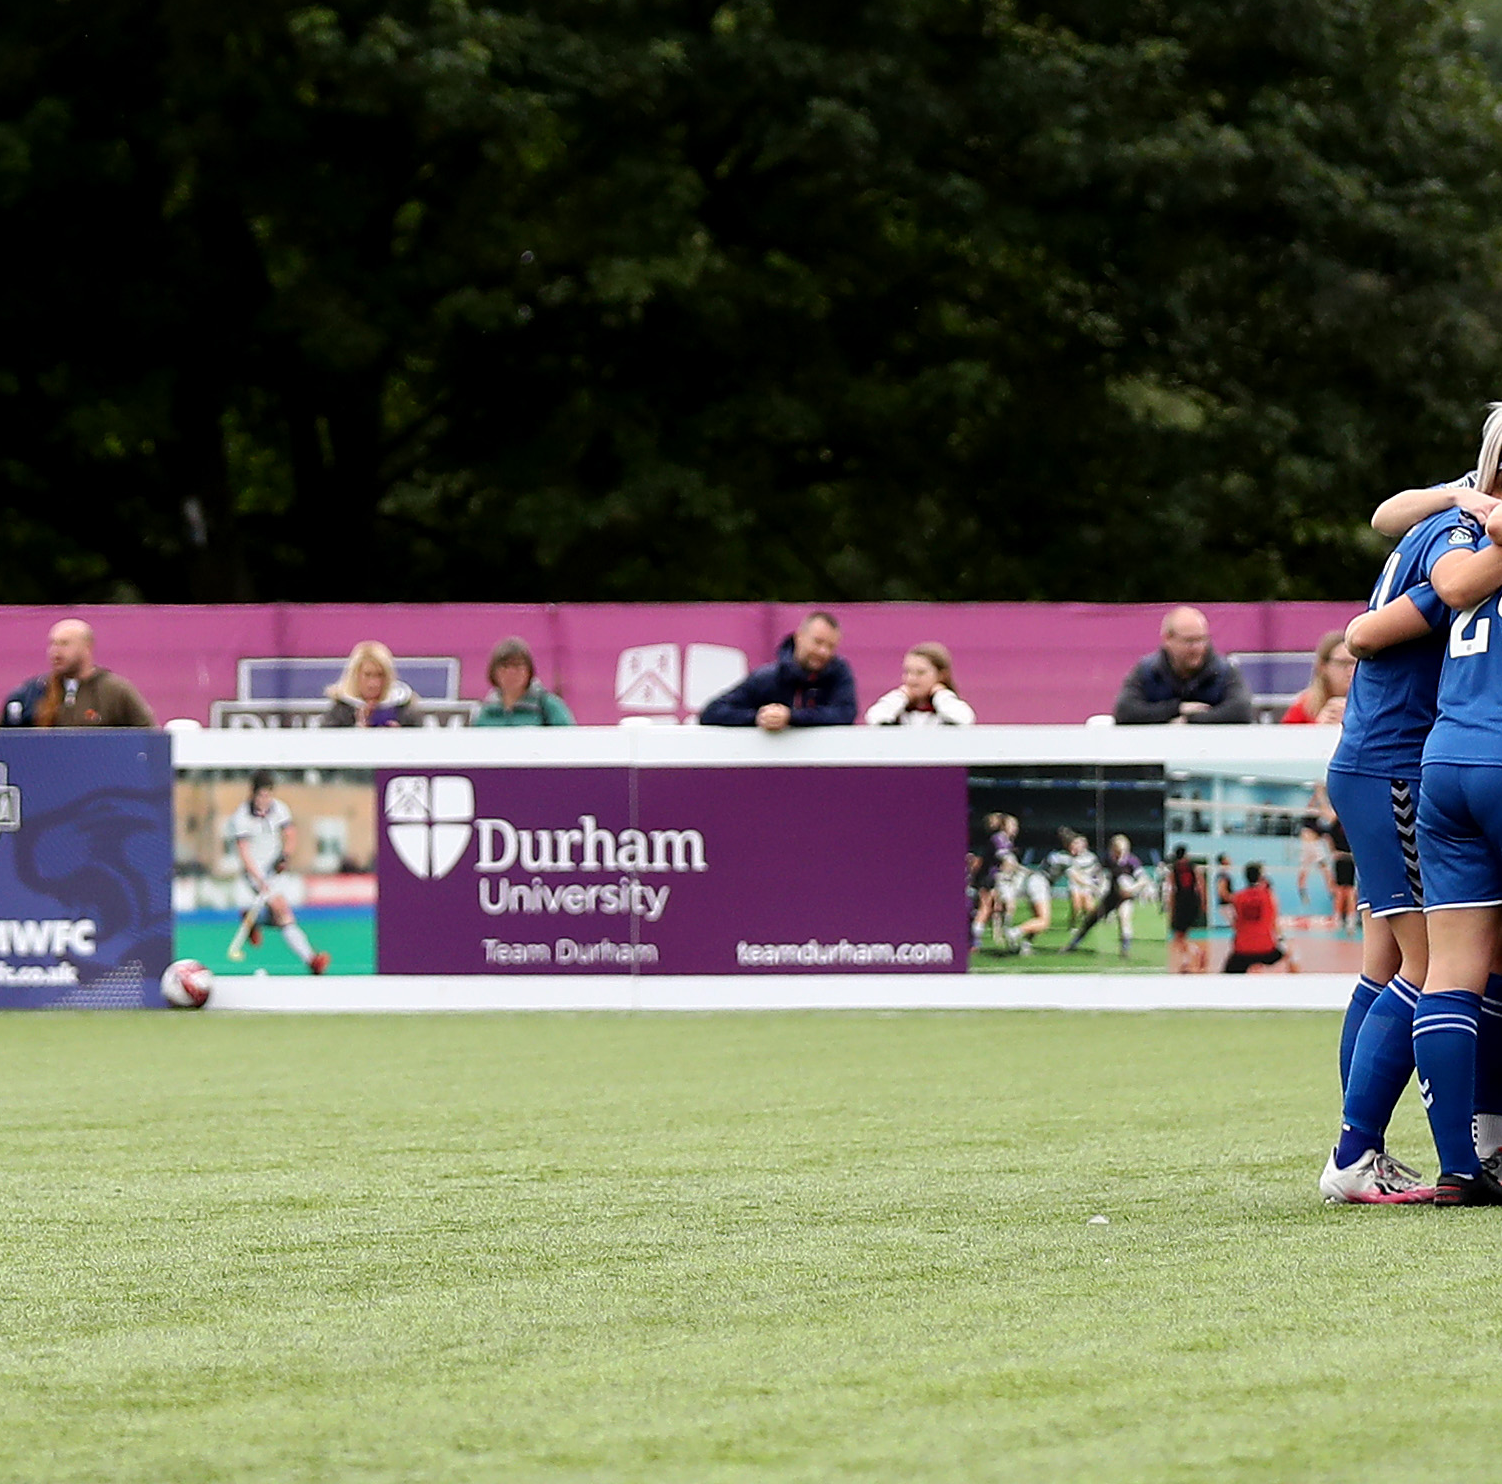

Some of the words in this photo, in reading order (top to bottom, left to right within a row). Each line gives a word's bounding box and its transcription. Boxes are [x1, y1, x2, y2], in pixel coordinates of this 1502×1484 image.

[474, 815, 708, 873] Durham
[477, 875, 671, 923] University
[481, 938, 551, 965] Team
[555, 938, 660, 966] Durham
[736, 938, 955, 967] teamdurham.com
